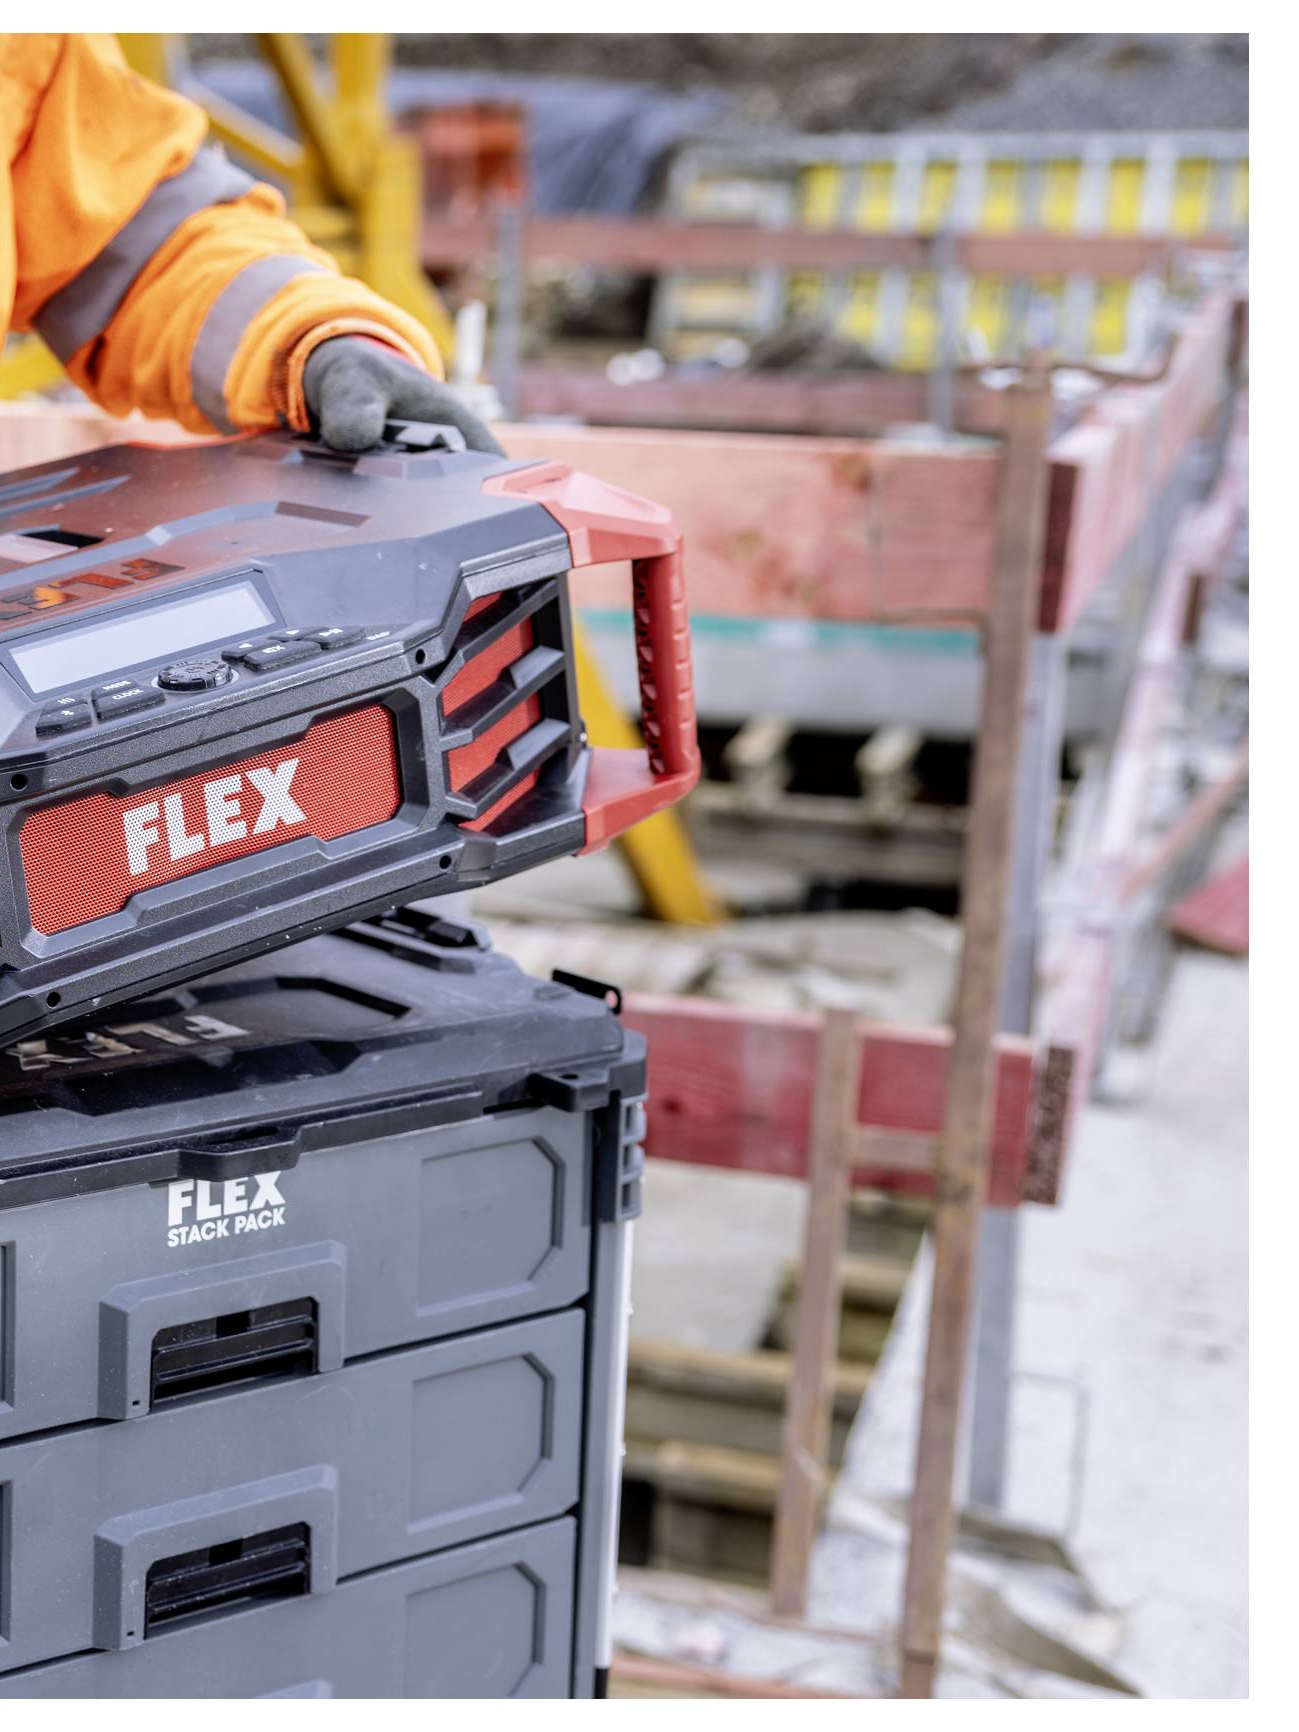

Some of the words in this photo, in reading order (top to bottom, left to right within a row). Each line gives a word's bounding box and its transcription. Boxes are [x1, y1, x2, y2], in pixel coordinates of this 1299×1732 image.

[123, 757, 308, 877] FLEX
[167, 1170, 286, 1227] FLEX
[167, 1218, 230, 1247] STACK
[234, 1206, 287, 1235] PACK
